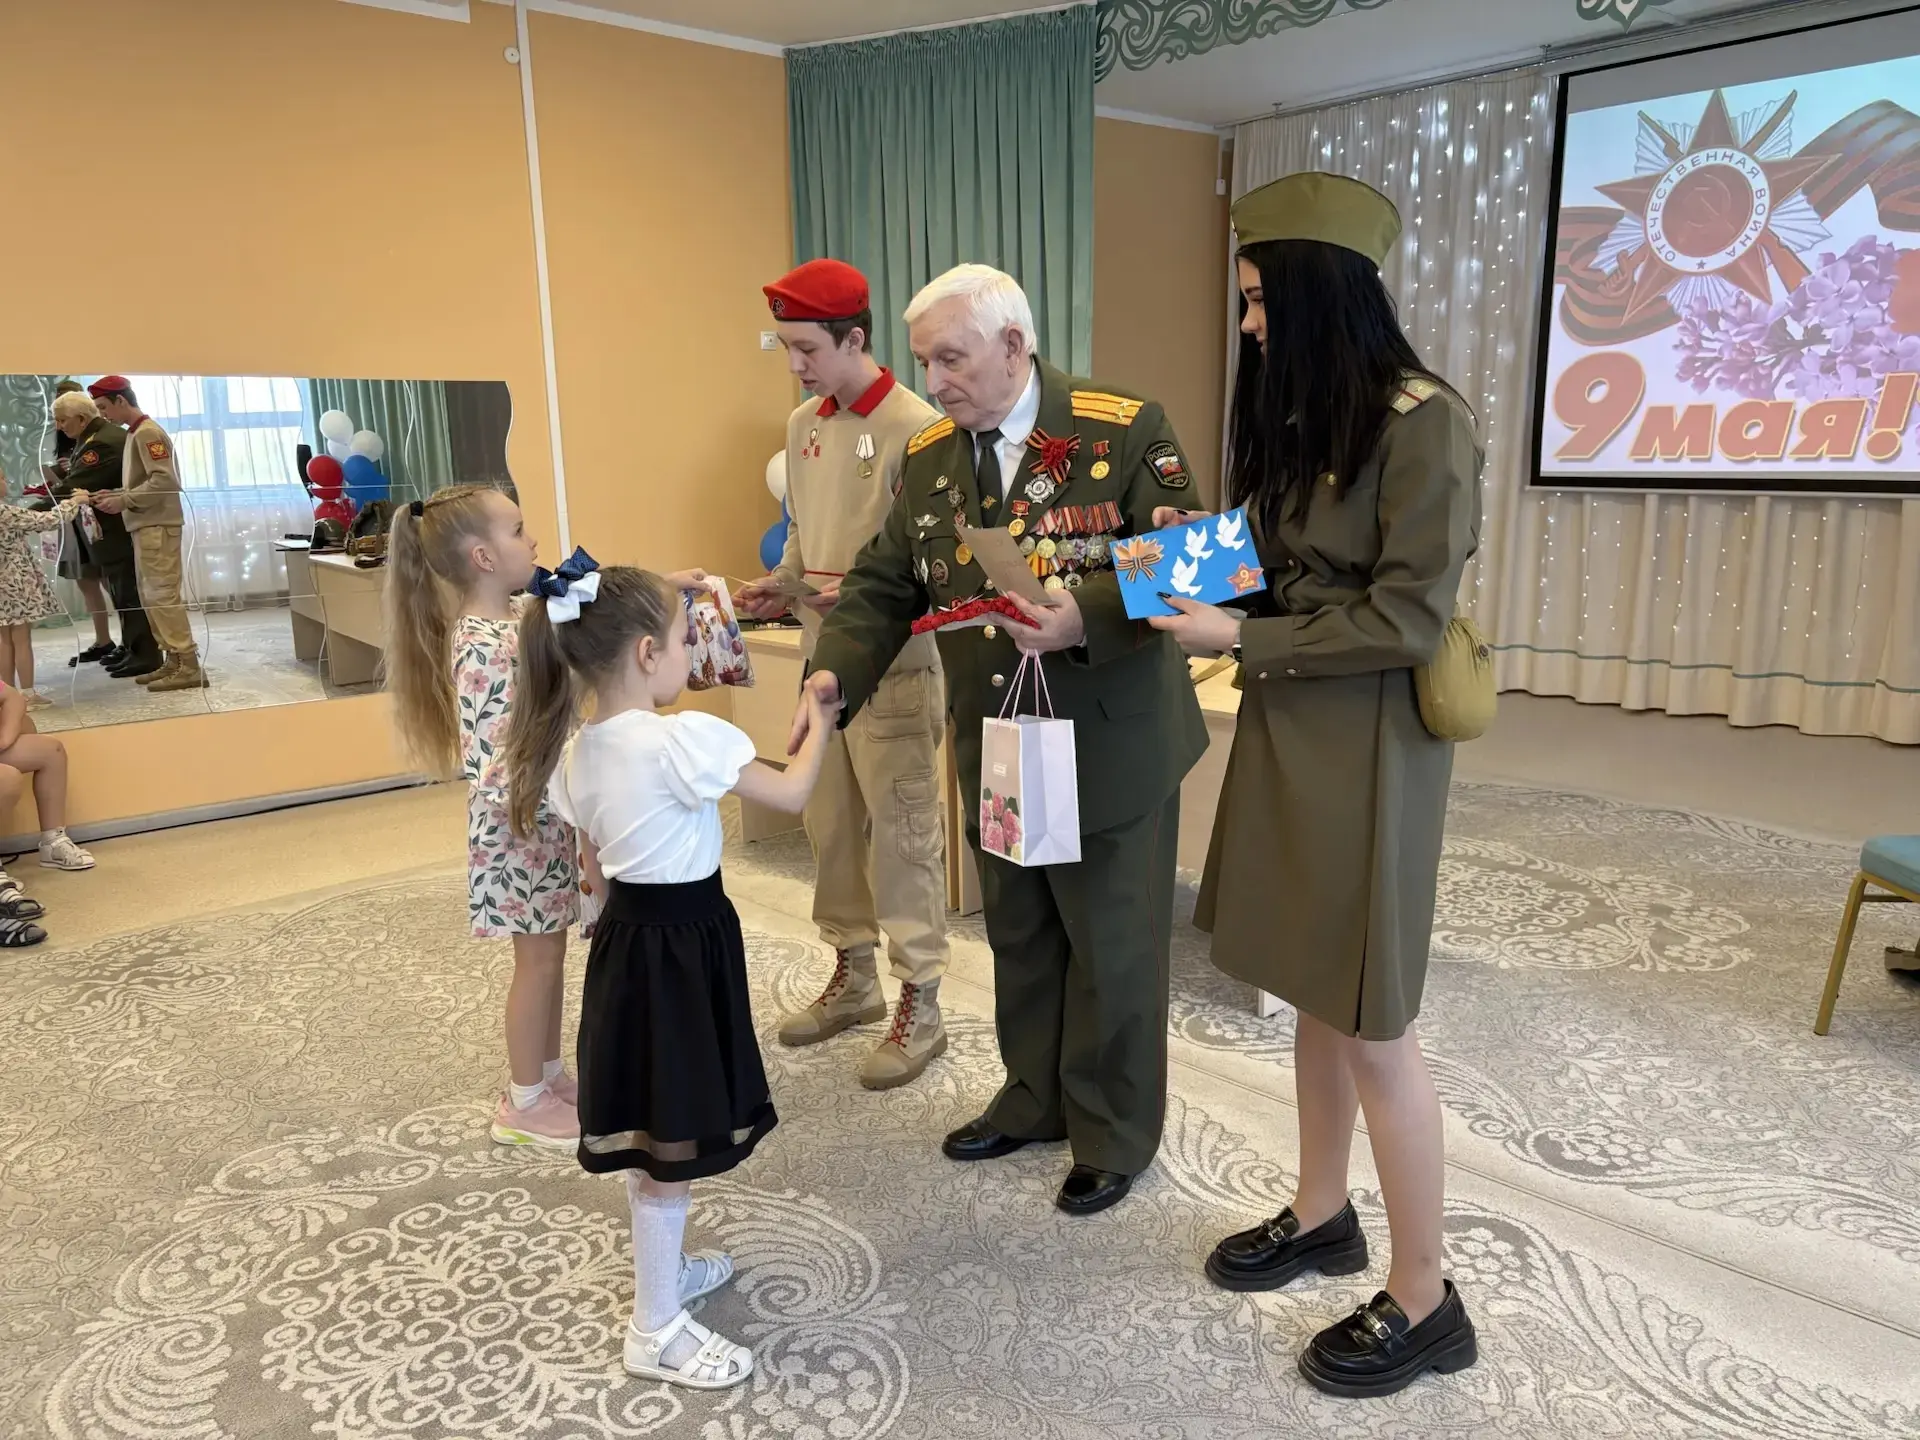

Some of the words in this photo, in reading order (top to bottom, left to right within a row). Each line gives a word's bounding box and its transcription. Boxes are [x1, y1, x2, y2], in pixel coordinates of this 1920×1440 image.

[1649, 150, 1761, 262] ОТЕЧЕСТВЕННАЯ
[1725, 187, 1767, 258] ВОЙНА
[1553, 351, 1647, 461] 9
[1628, 371, 1919, 462] мая!
[1240, 569, 1250, 582] 9
